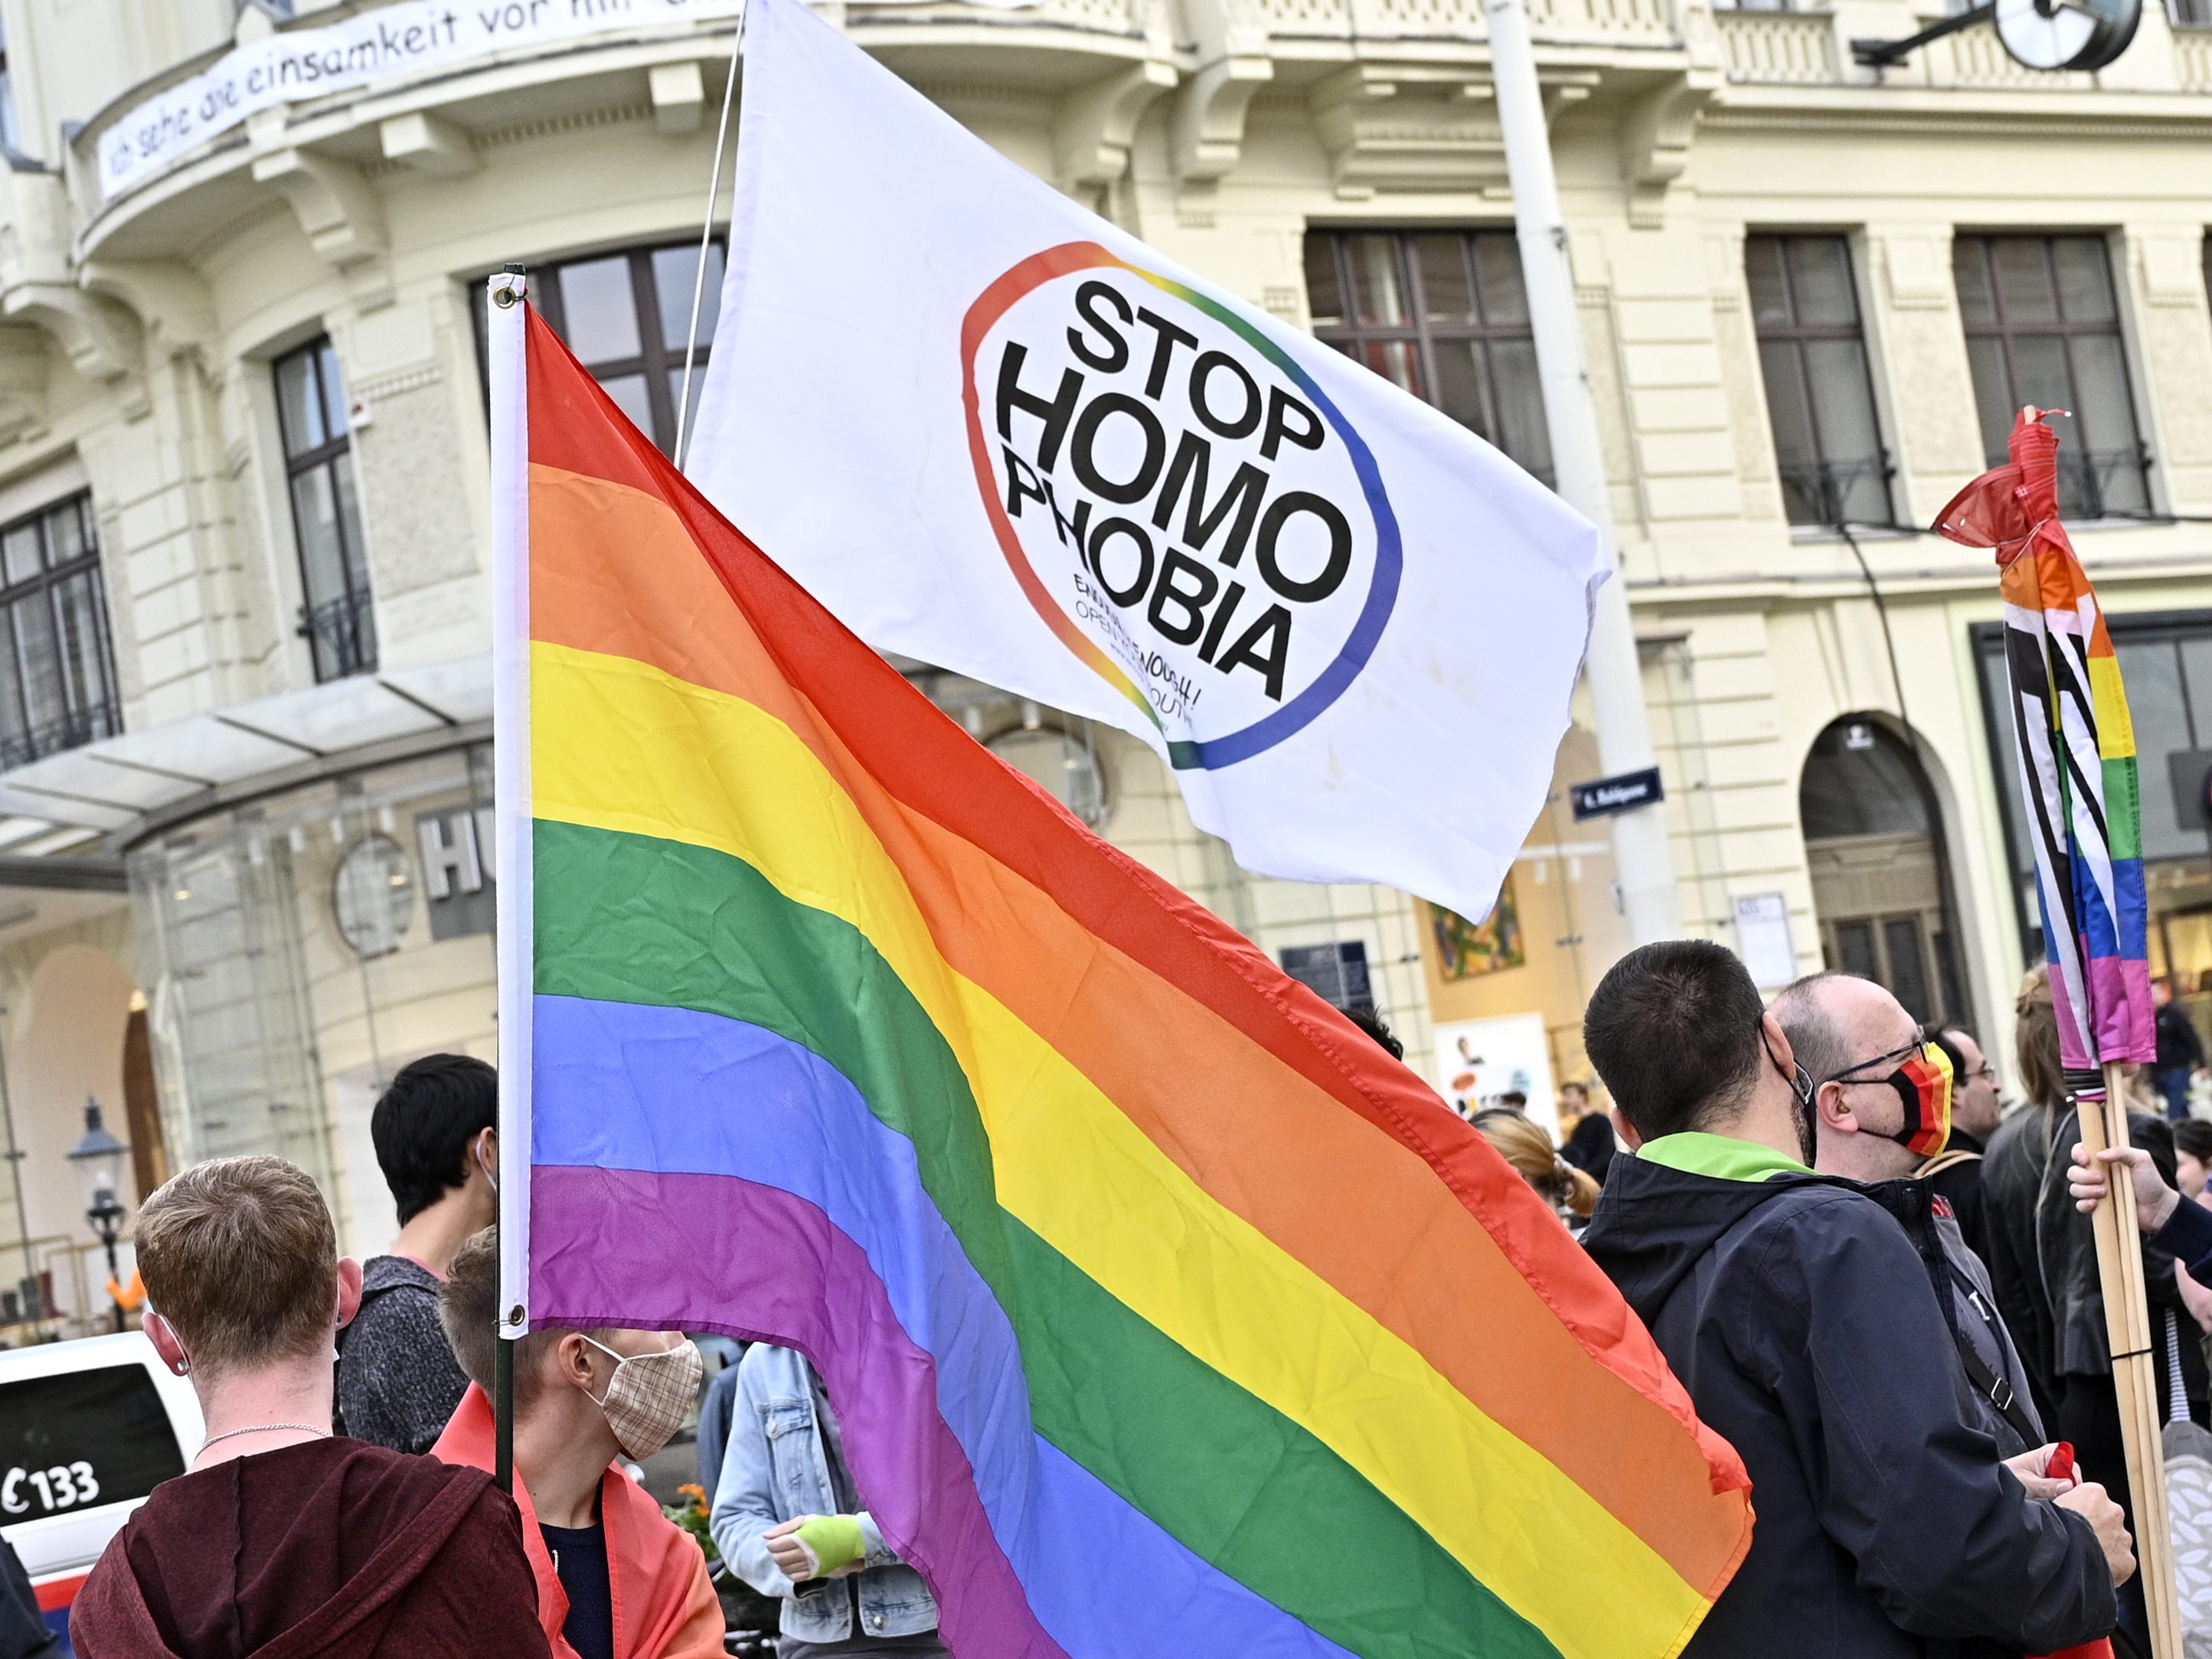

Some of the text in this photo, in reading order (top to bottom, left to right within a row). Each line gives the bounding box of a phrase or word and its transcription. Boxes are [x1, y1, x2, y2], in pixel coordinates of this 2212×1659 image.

[247, 9, 457, 94] einsamkeit
[479, 0, 549, 32] vor
[996, 340, 1353, 603] HOMO
[1067, 280, 1325, 462] STOP
[1000, 443, 1292, 702] PHOBIA
